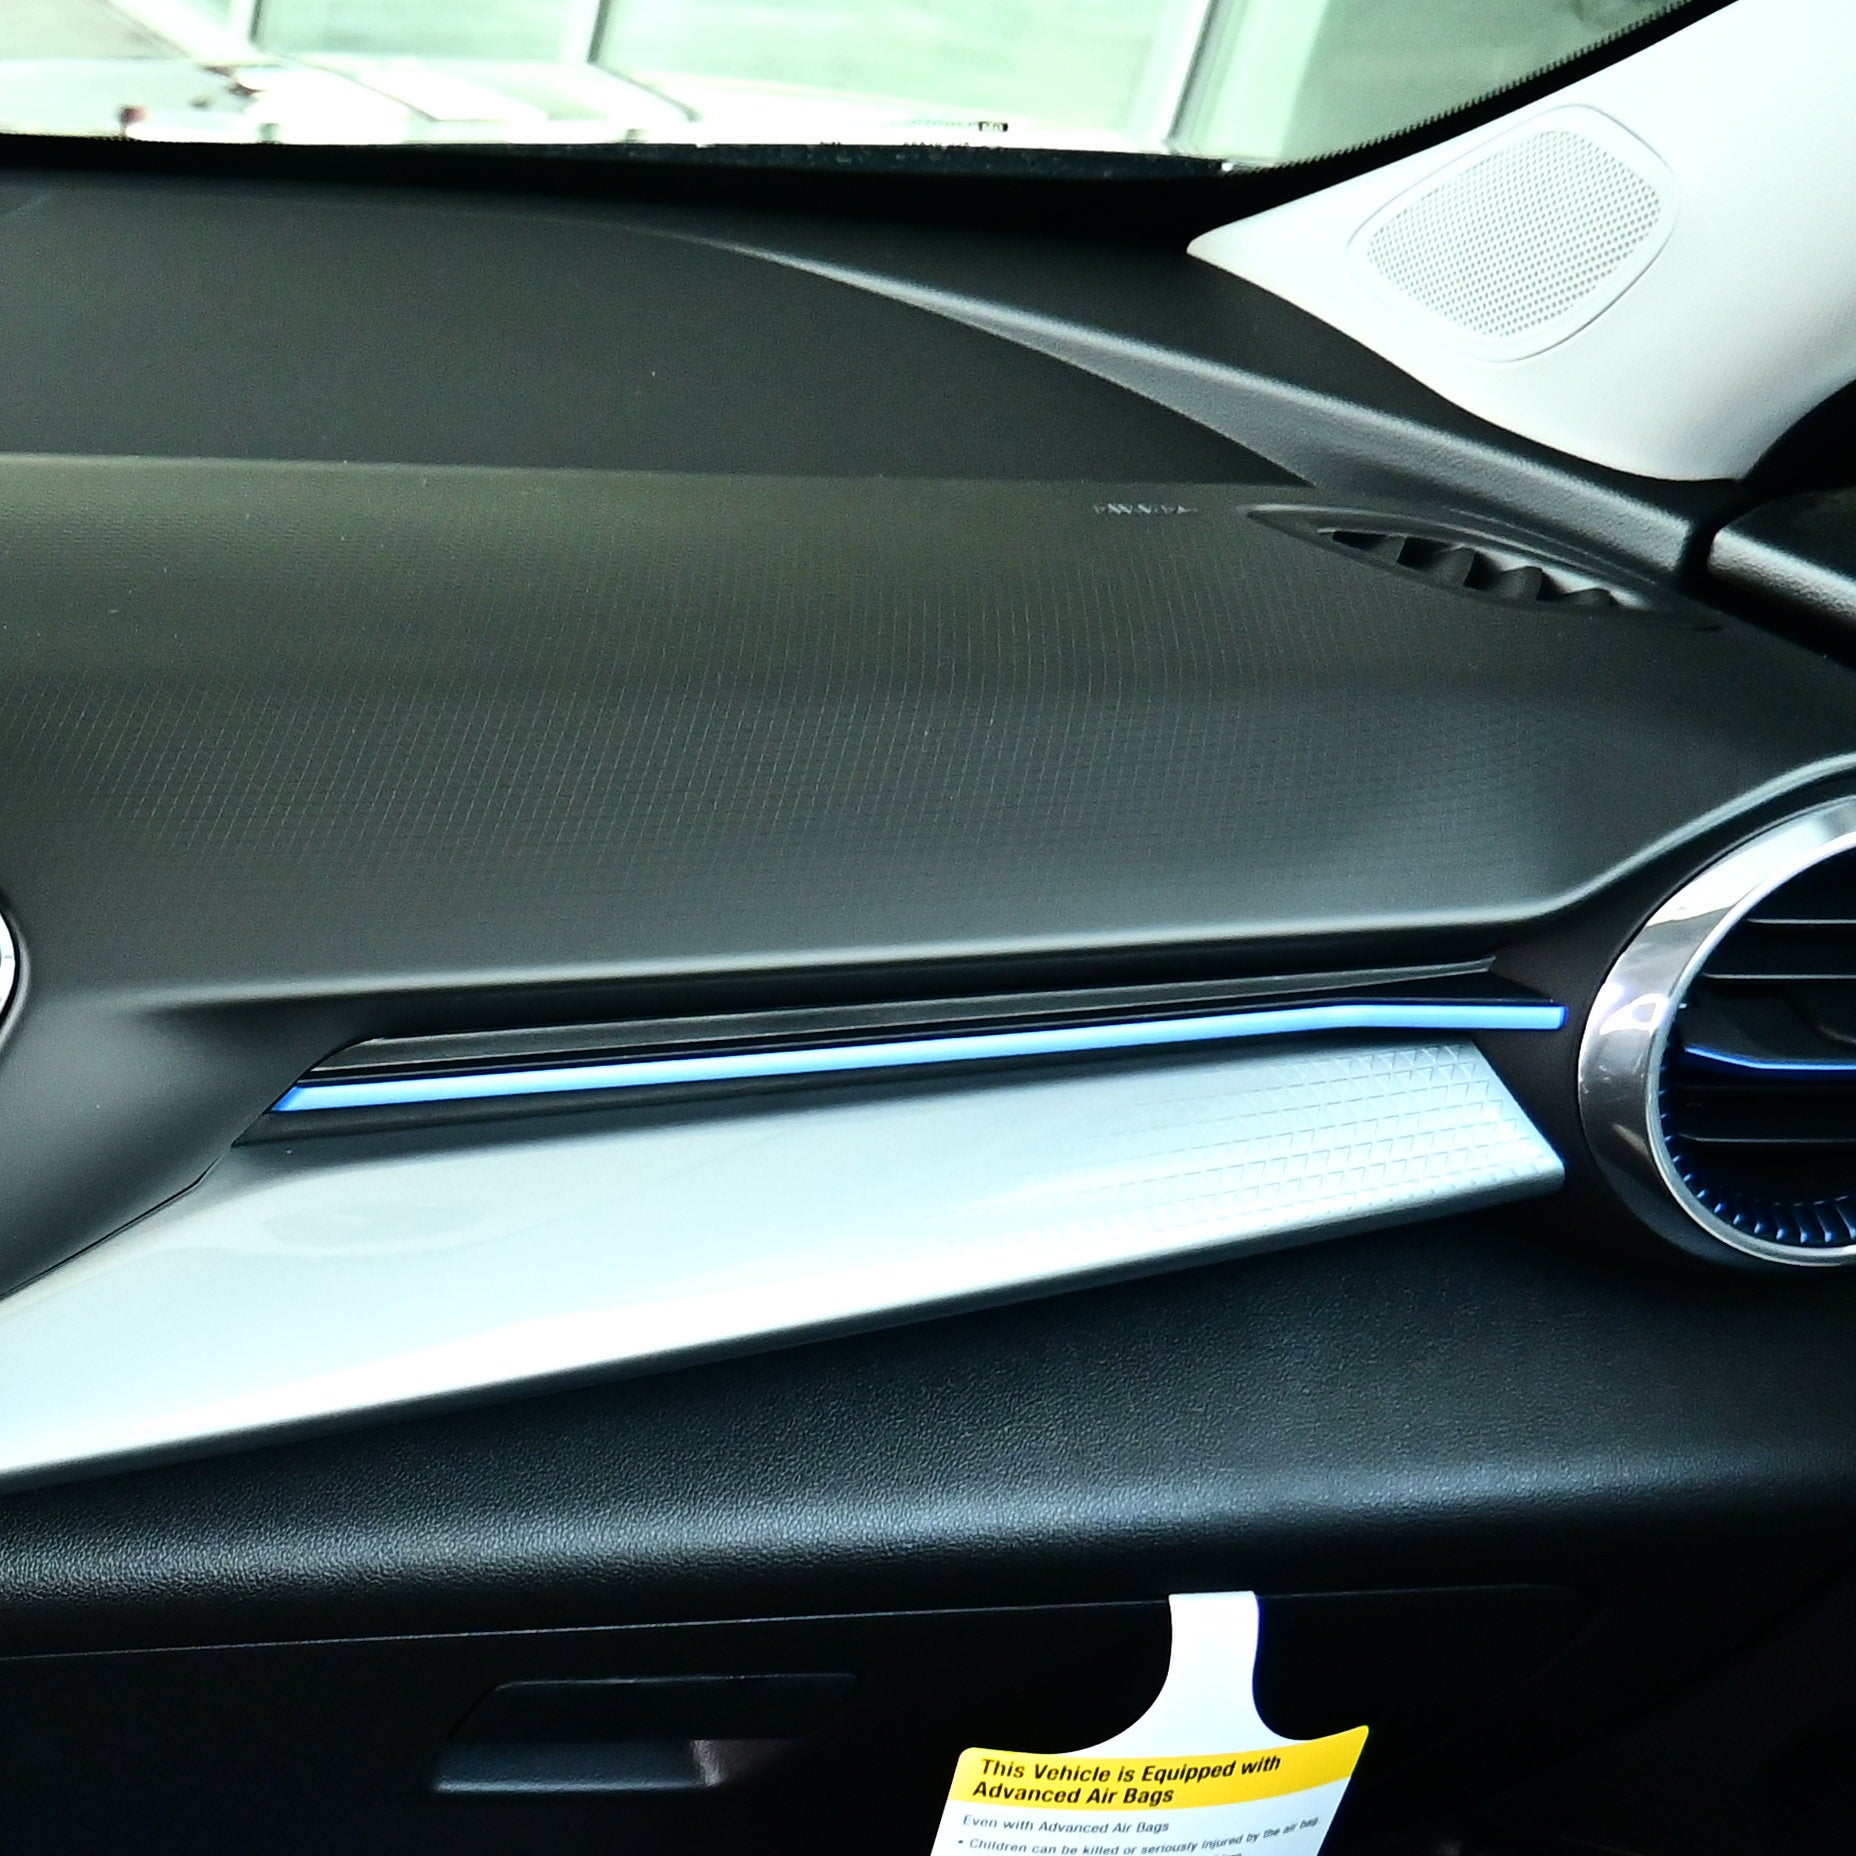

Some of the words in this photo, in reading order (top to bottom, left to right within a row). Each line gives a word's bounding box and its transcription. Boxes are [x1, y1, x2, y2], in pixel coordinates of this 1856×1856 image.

[981, 1759, 1025, 1780] This
[1033, 1763, 1111, 1784] Vehicle
[1117, 1765, 1136, 1783] is
[1141, 1760, 1236, 1785] Equipped
[1240, 1755, 1281, 1776] with
[973, 1781, 1081, 1804] Advanced
[1086, 1787, 1118, 1804] Air
[1123, 1786, 1174, 1807] Bags
[963, 1814, 999, 1829] Even
[1003, 1816, 1036, 1831] with
[1038, 1818, 1109, 1834] Advanced
[1112, 1820, 1132, 1833] Air
[1136, 1819, 1169, 1835] Bags
[969, 1836, 1028, 1854] Children
[1031, 1842, 1058, 1855] can
[1061, 1842, 1078, 1856] be
[1081, 1841, 1119, 1856] killed
[1122, 1843, 1138, 1856] or
[1140, 1838, 1198, 1856] seriously
[1200, 1833, 1243, 1850] injured
[1246, 1832, 1260, 1845] by
